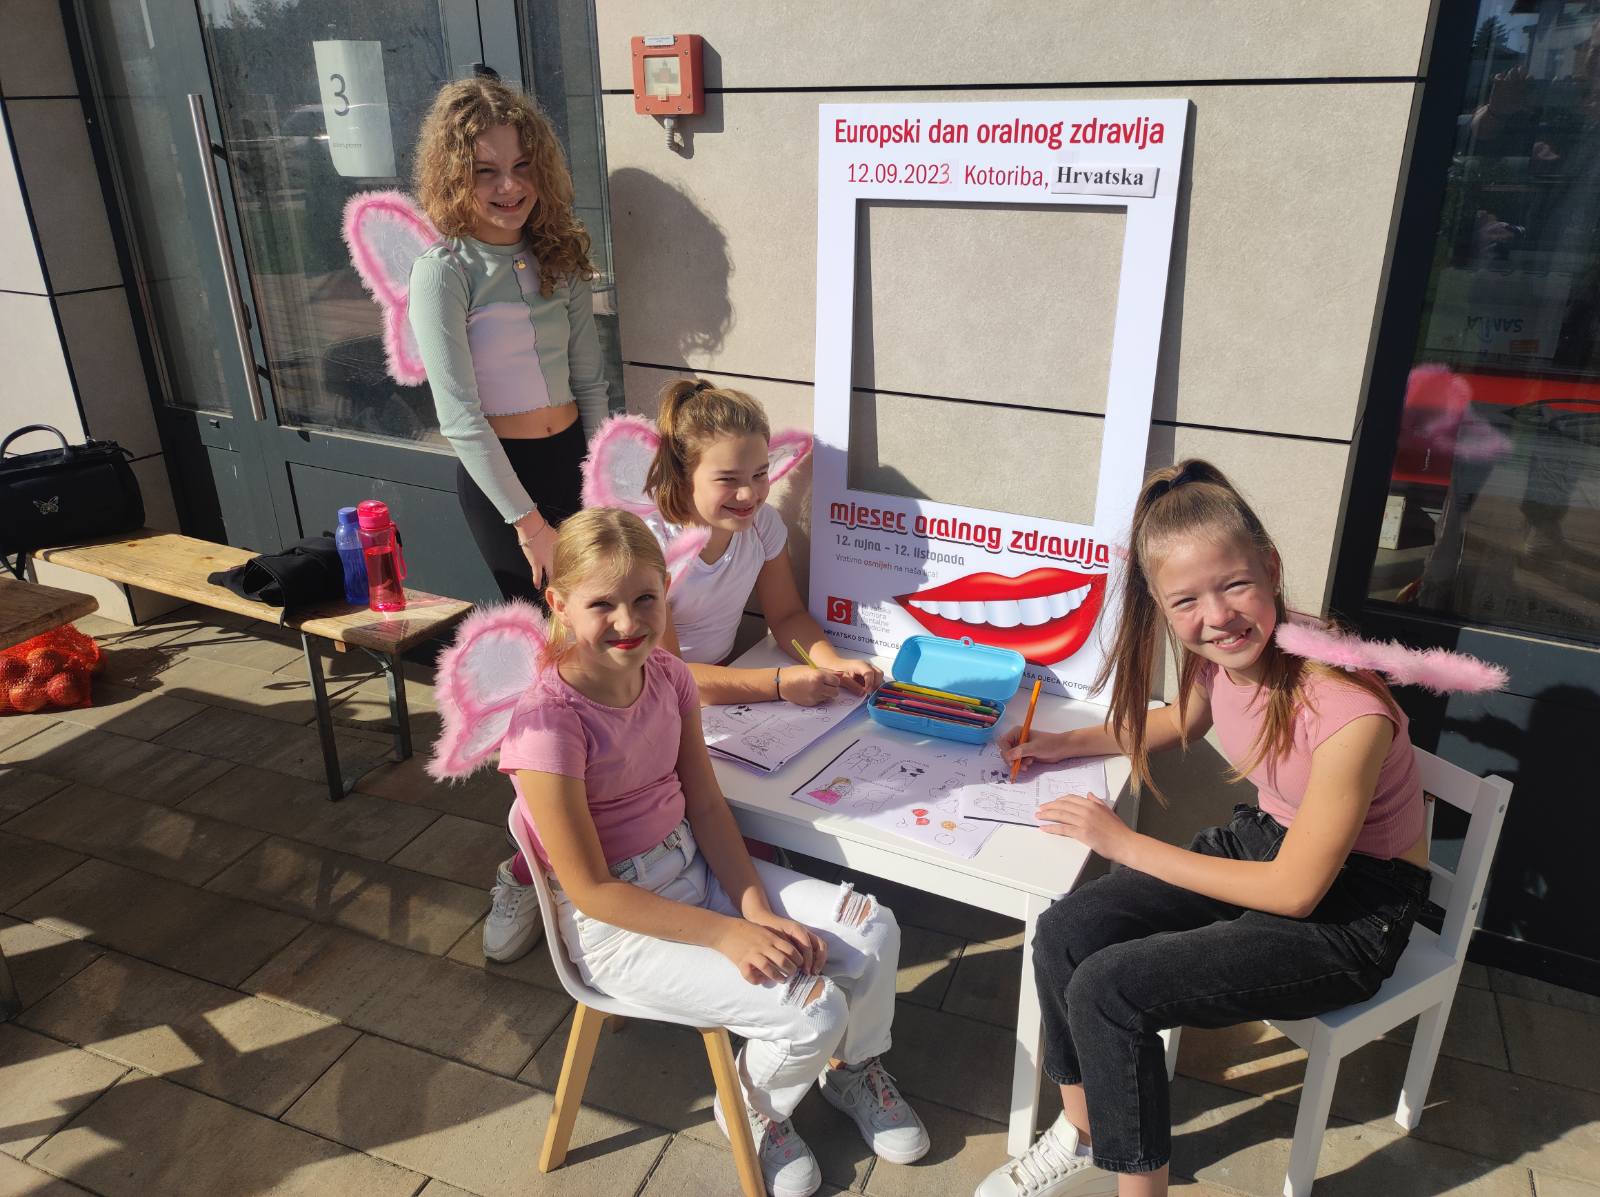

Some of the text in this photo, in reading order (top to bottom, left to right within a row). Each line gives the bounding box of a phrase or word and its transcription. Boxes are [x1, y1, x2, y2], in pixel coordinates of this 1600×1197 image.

[330, 73, 350, 117] 3
[834, 117, 1165, 150] Europski dan oralnog zdravlja
[964, 164, 1050, 190] Kotoriba,
[1056, 166, 1145, 187] Hrvatska
[829, 501, 1110, 566] mjesec oralnog zdravlja
[835, 534, 851, 546] 12.
[854, 538, 881, 551] rujna
[894, 543, 910, 557] 12.
[913, 547, 965, 566] listopada
[863, 559, 892, 570] osmijeh
[823, 629, 857, 641] HRVATSKO
[1037, 674, 1061, 685] DJECA
